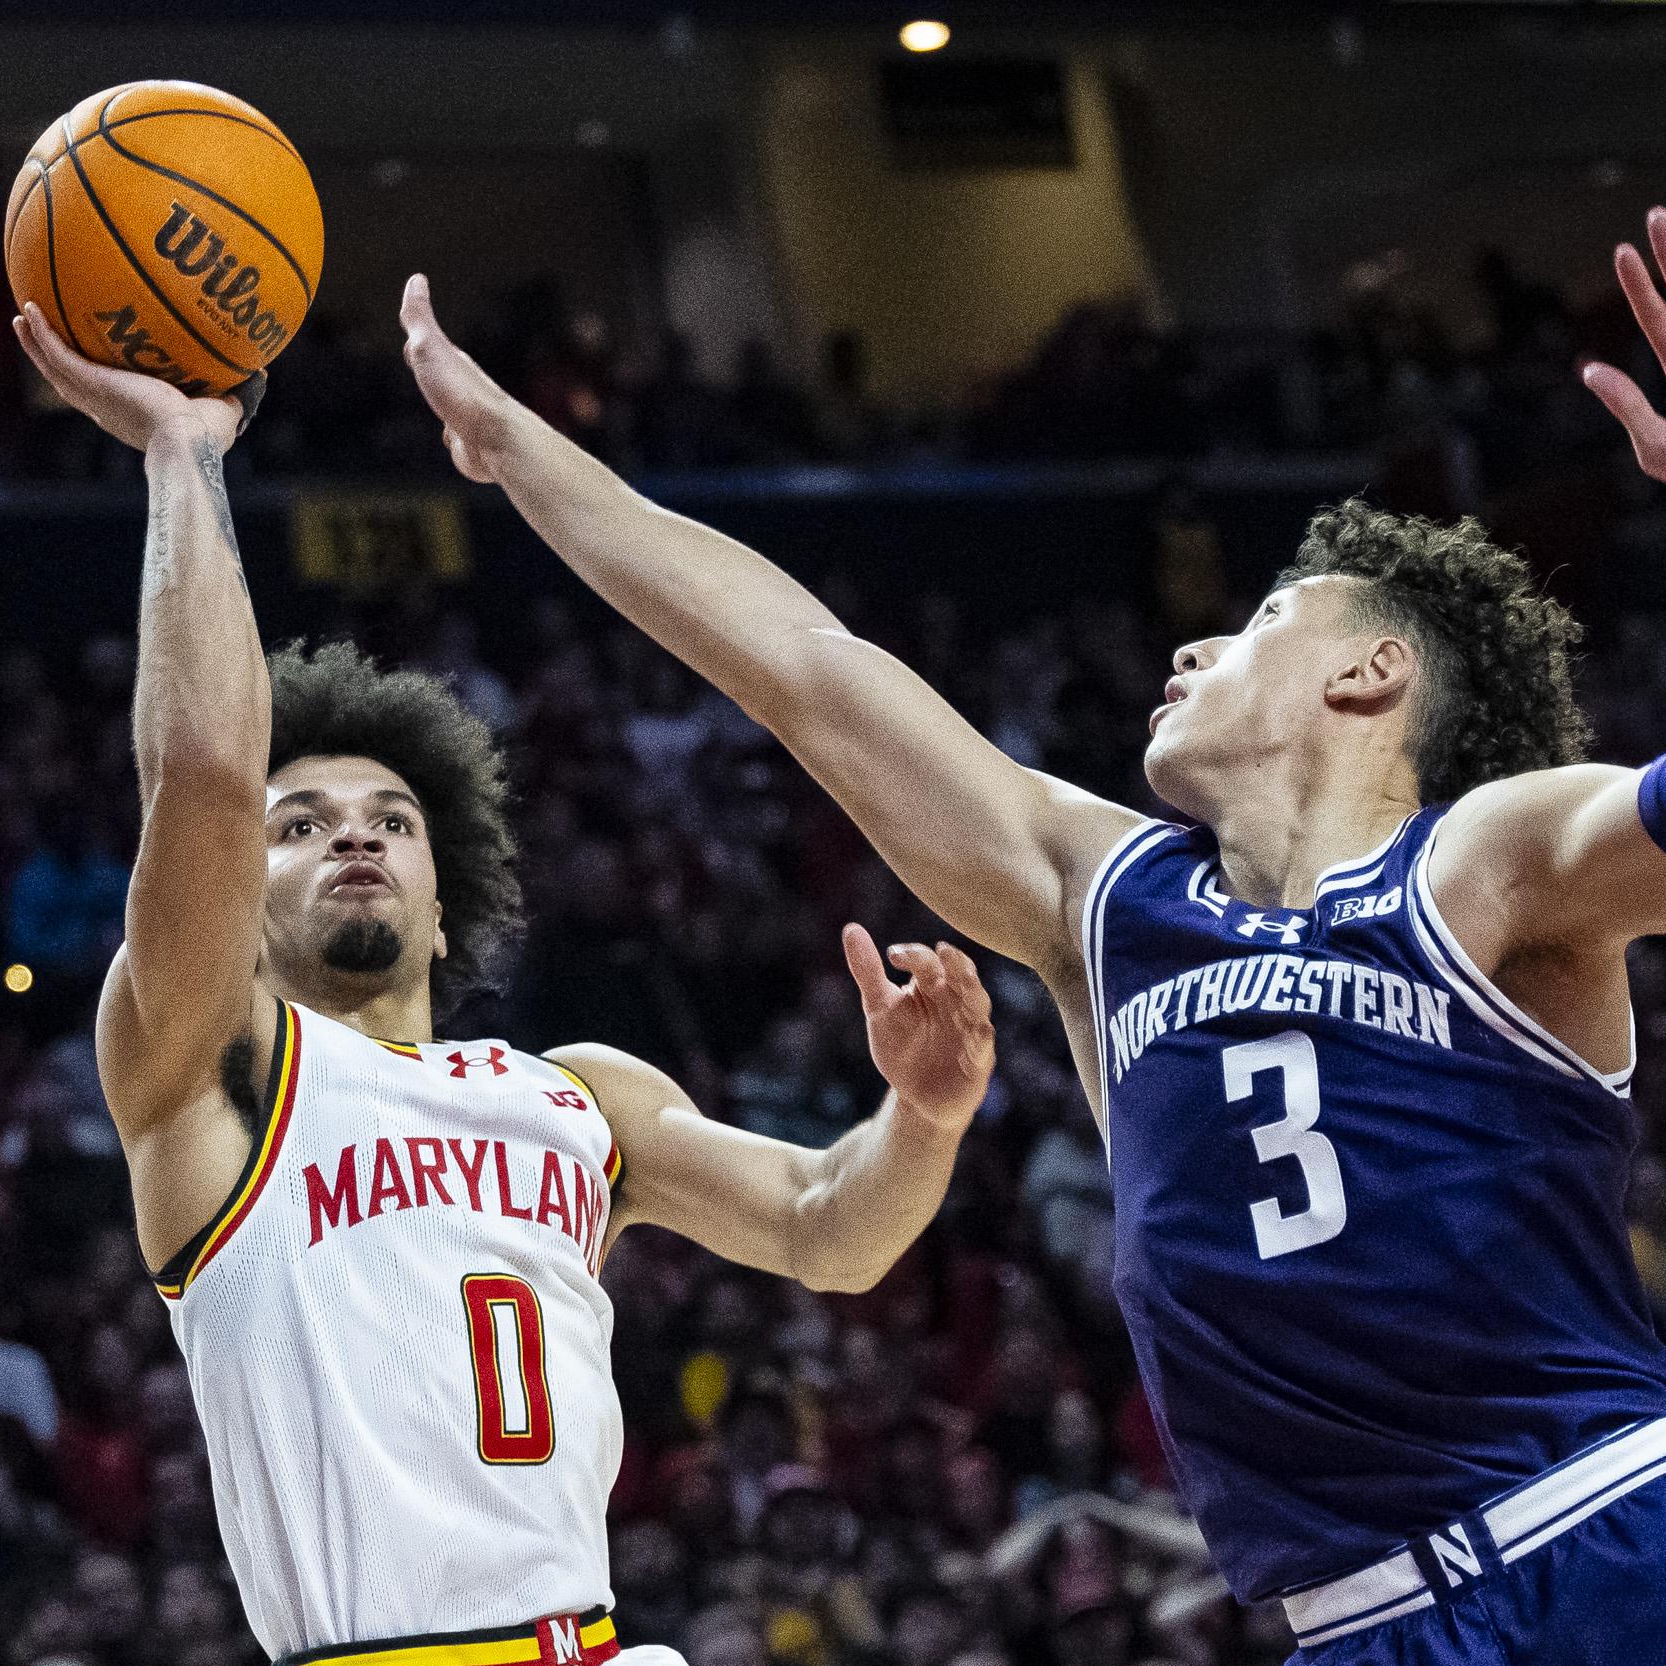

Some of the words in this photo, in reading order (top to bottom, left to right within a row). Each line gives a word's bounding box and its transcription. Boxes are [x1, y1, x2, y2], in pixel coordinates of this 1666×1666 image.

[154, 199, 286, 358] Wilson
[1109, 953, 1452, 1084] NORTHWESTERN
[1222, 1030, 1347, 1261] 3
[461, 1272, 556, 1466] 0
[1429, 1523, 1483, 1588] N
[548, 1618, 582, 1665] M
